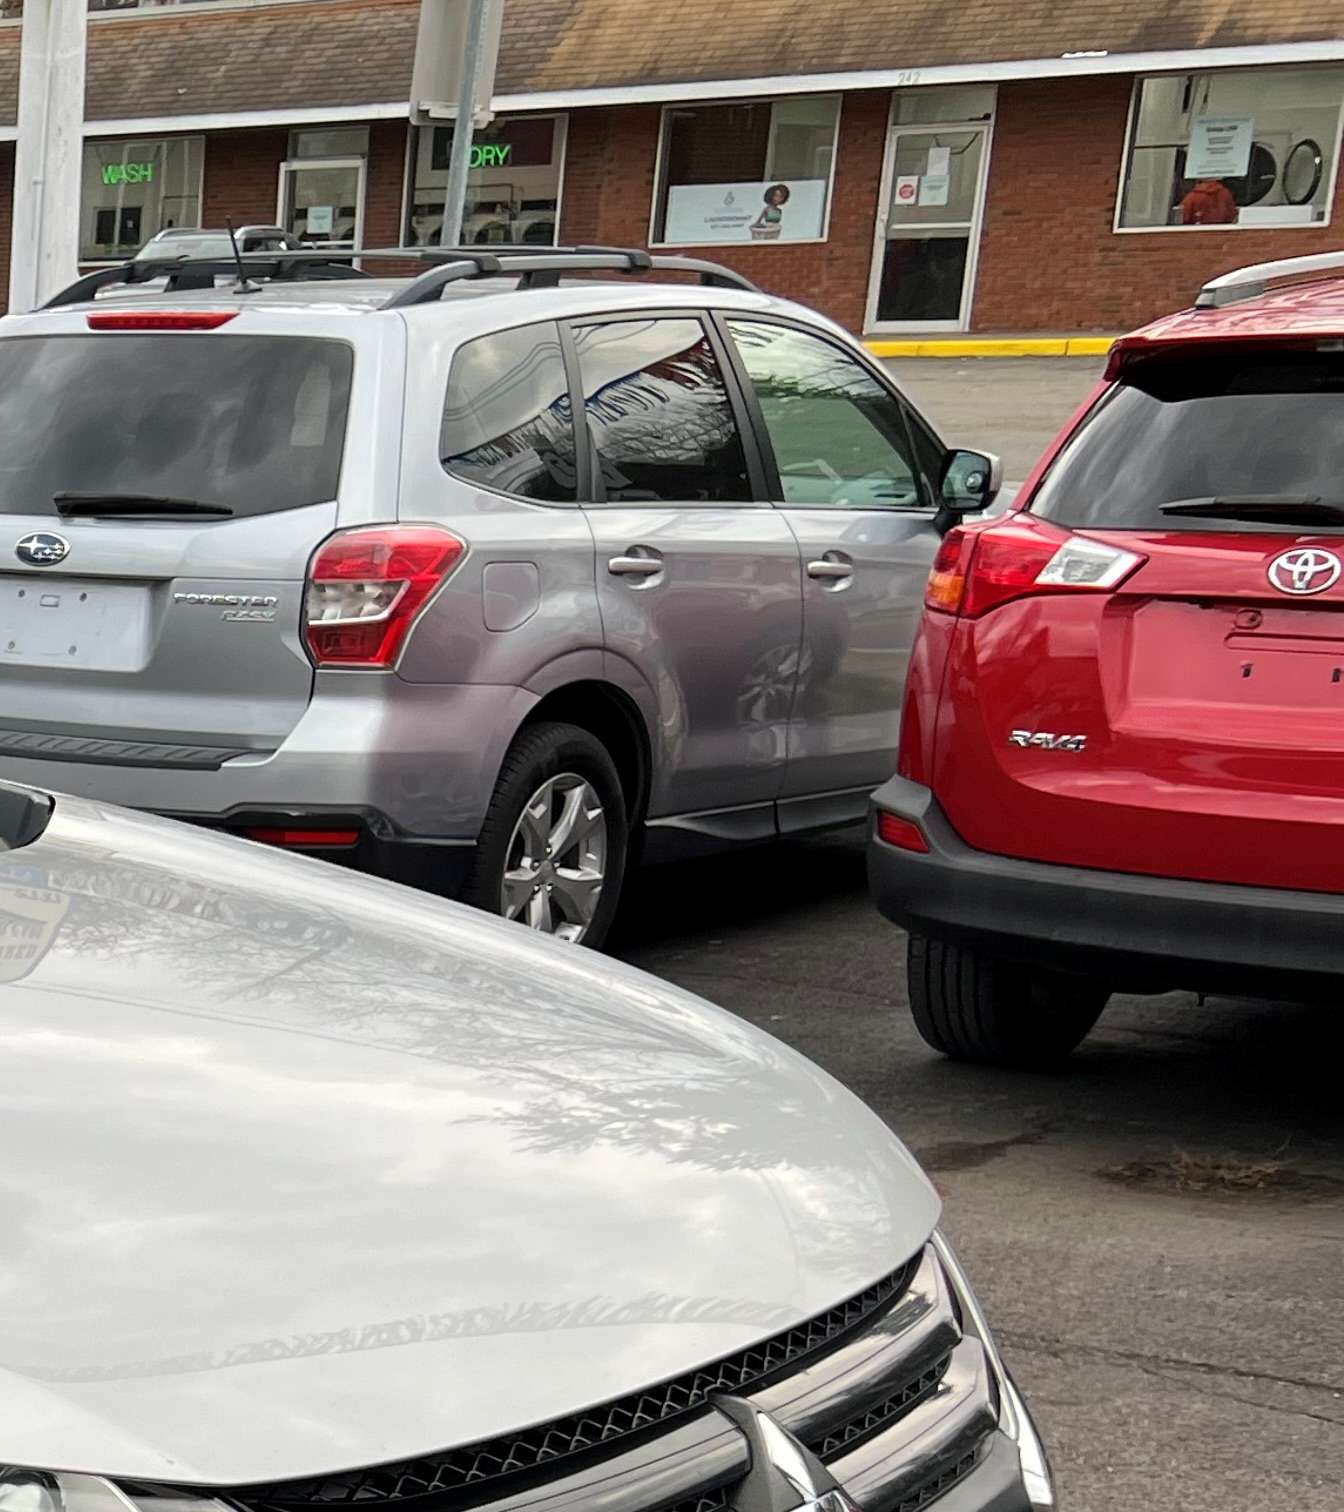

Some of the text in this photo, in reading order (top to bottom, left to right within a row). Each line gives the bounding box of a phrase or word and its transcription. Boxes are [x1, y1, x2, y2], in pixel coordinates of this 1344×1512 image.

[102, 163, 152, 184] WASH
[173, 593, 278, 607] FORESTER
[1009, 730, 1087, 752] RAV4
